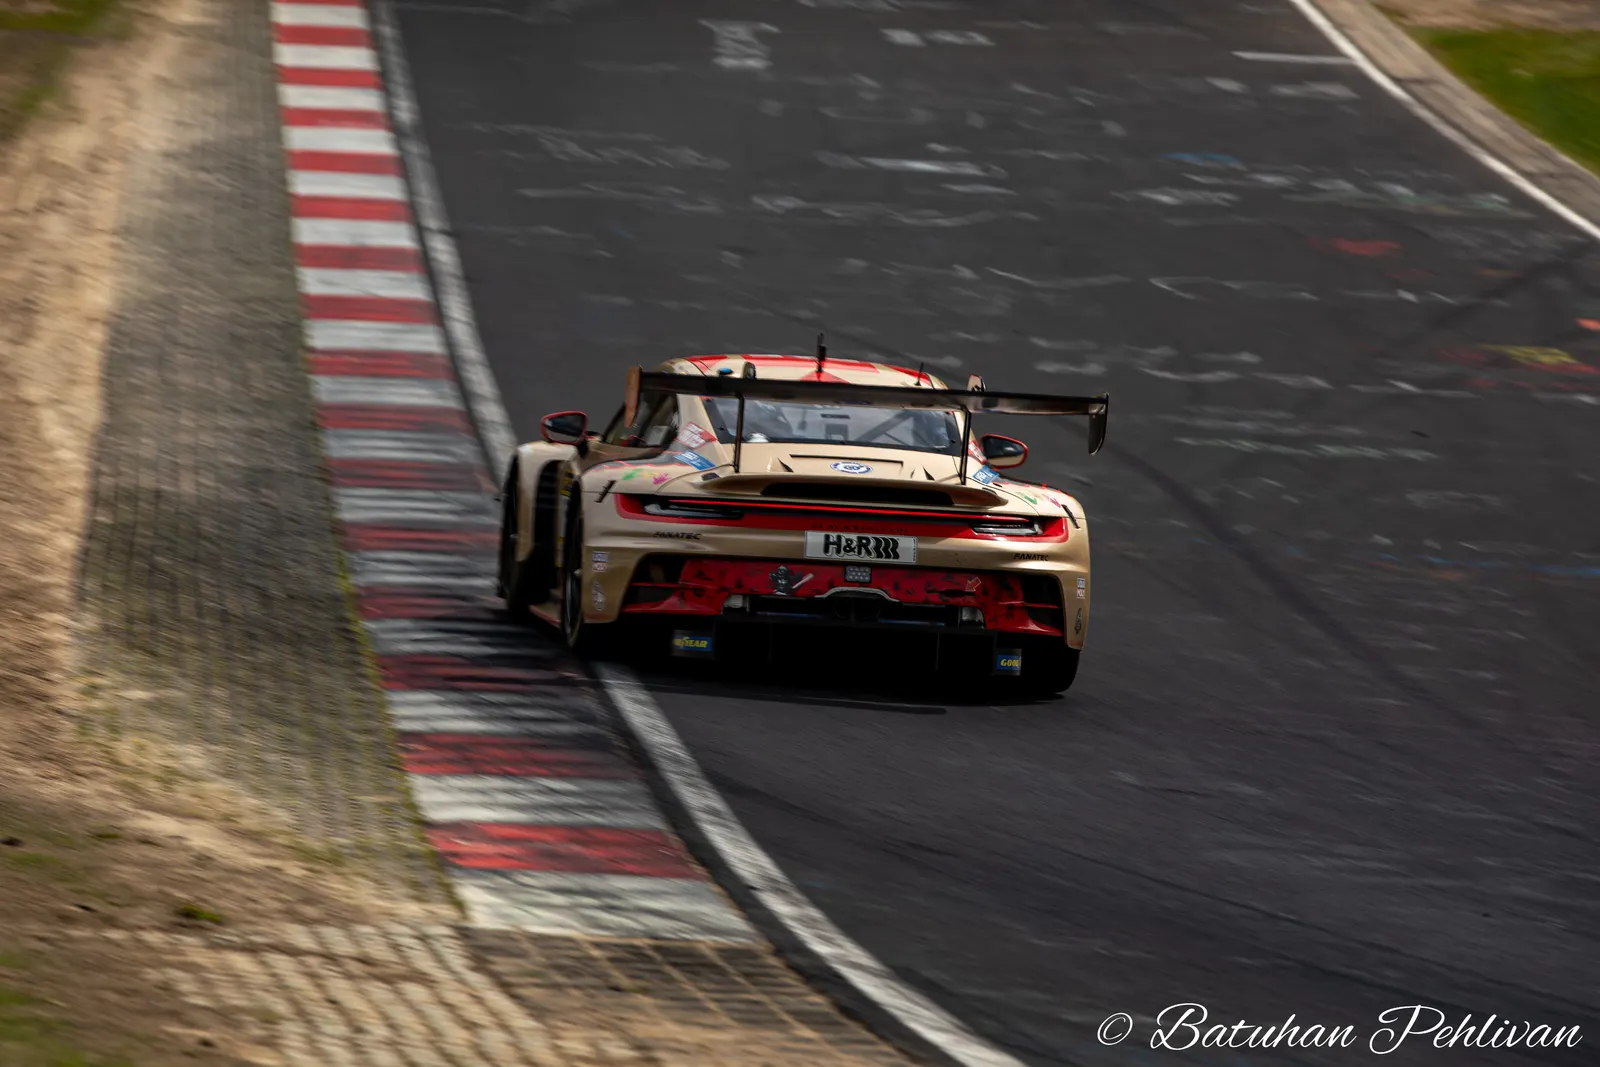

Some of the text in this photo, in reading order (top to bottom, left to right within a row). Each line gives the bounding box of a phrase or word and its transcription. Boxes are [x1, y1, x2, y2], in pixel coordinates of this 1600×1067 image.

[653, 531, 702, 540] FANATEC
[823, 533, 875, 559] H&R
[1013, 553, 1049, 562] FANATEC
